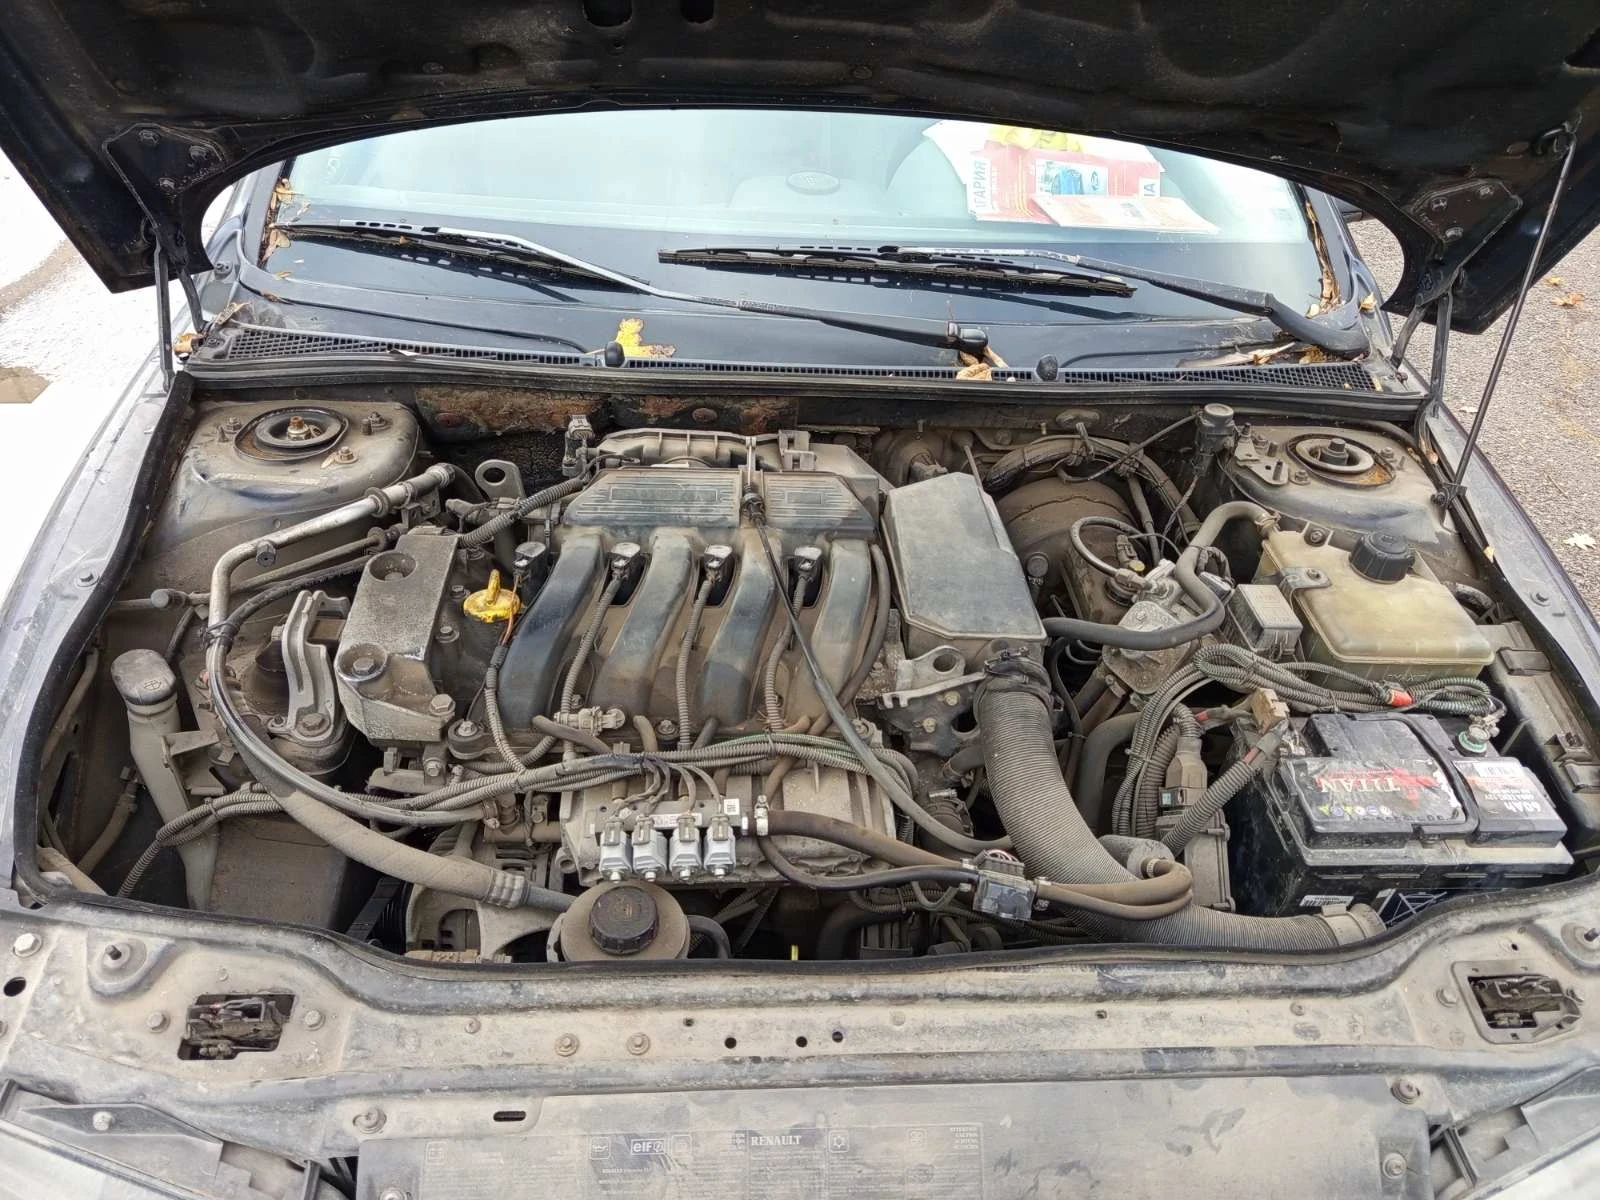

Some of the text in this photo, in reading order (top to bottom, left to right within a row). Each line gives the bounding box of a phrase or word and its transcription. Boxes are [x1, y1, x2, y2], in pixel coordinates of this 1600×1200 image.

[1319, 777, 1401, 793] TITAN
[632, 1140, 653, 1153] elf
[750, 1135, 802, 1147] RENAULT
